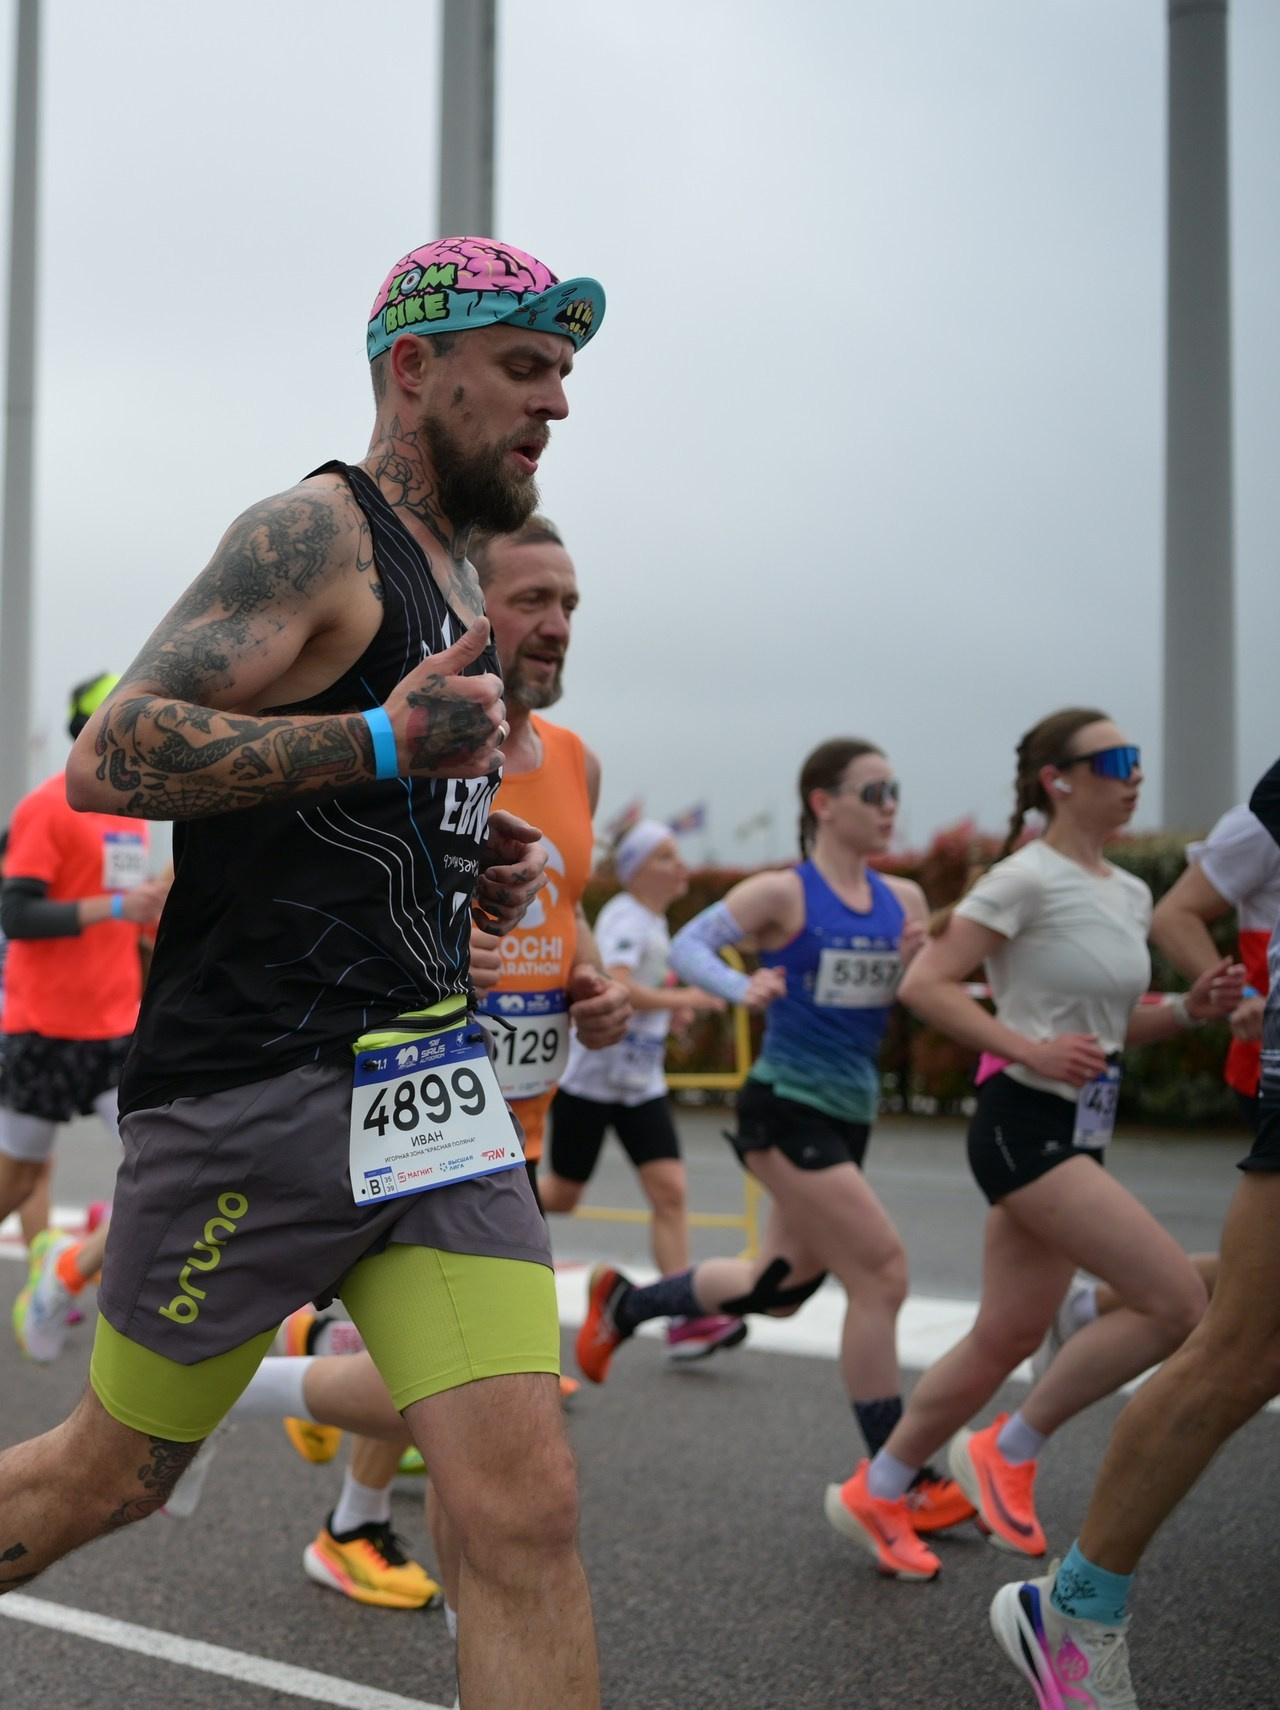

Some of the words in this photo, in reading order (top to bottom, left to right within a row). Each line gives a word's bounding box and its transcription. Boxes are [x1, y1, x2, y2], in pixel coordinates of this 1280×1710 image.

[385, 290, 449, 336] BIKE
[498, 935, 563, 960] OCHI
[497, 961, 561, 976] ARATHON
[421, 1044, 446, 1058] SIRIUS
[363, 1067, 486, 1136] 4899
[411, 1131, 444, 1147] ИВАН
[384, 1152, 410, 1163] ИГОРНАЯ
[410, 1148, 425, 1158] ЗОНА
[448, 1155, 474, 1165] ВЫСШАЯ
[480, 1147, 505, 1161] RAY
[407, 1167, 433, 1179] МАГНИТ
[449, 1163, 465, 1171] ЛИГА
[386, 1185, 395, 1193] 39
[158, 1192, 248, 1324] bruno
